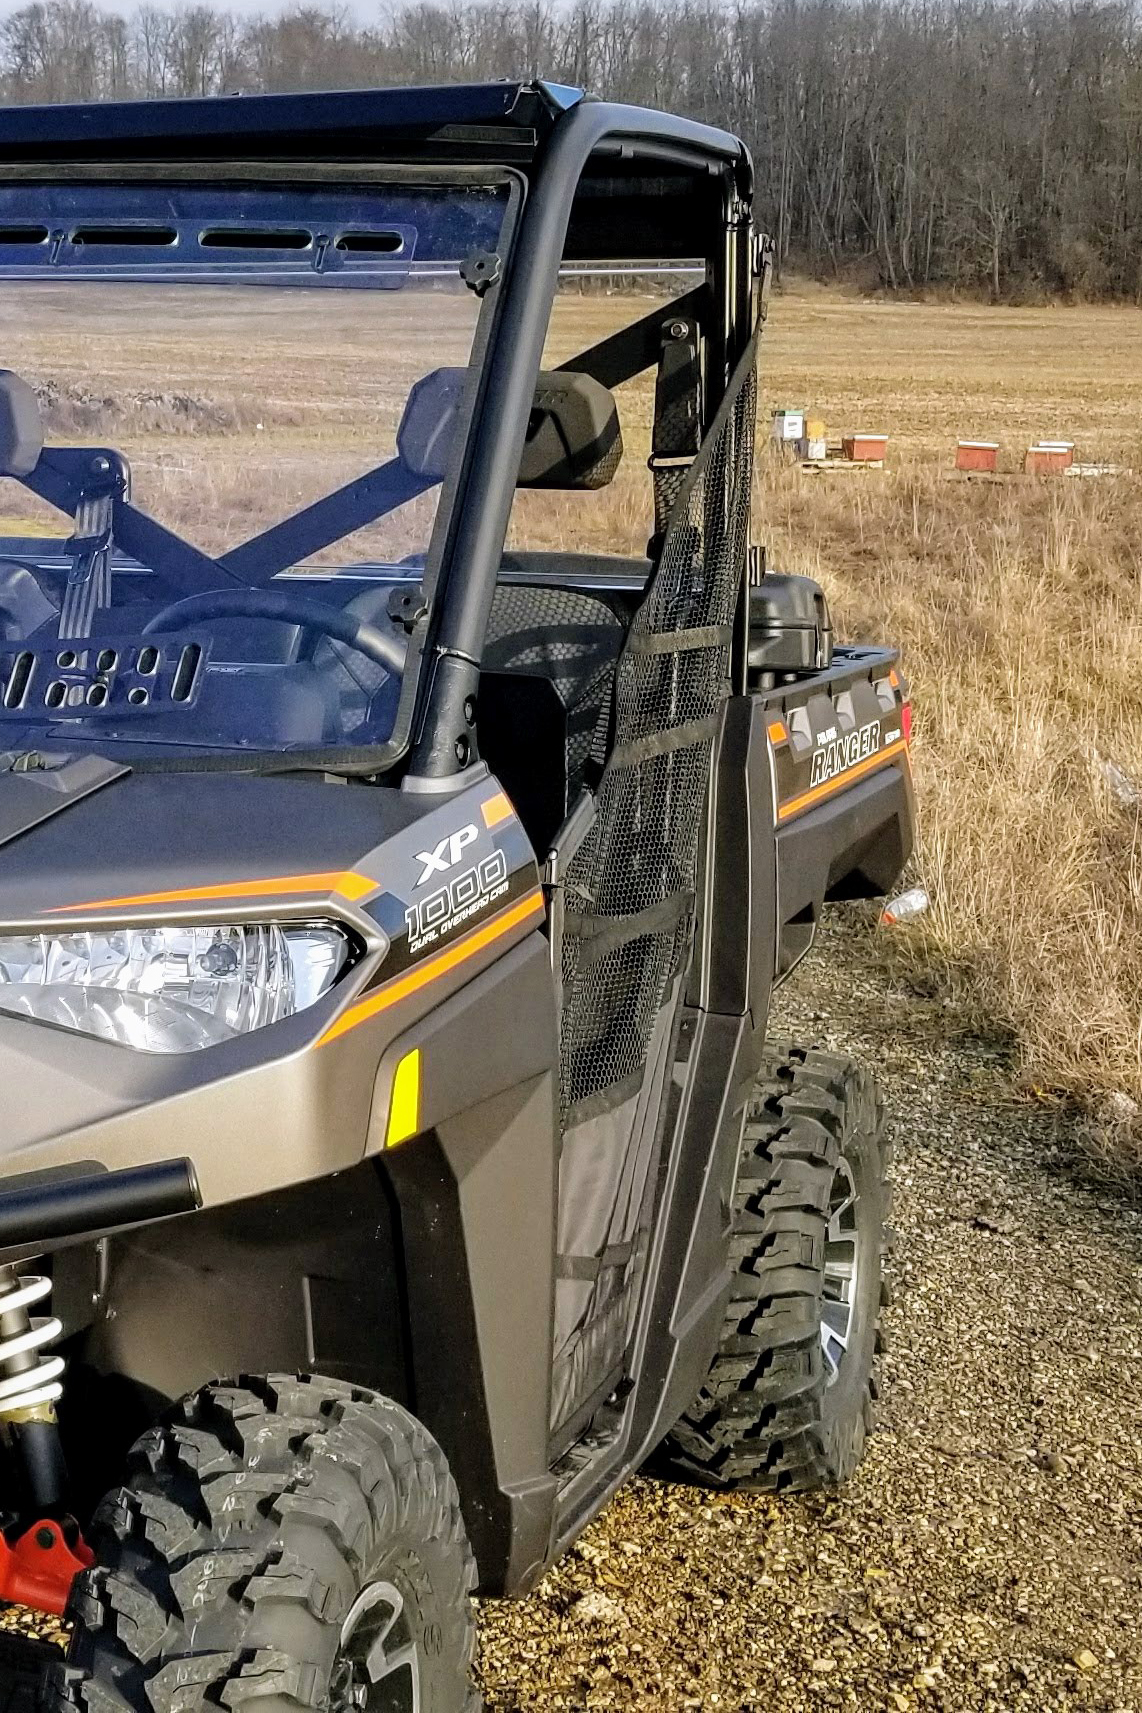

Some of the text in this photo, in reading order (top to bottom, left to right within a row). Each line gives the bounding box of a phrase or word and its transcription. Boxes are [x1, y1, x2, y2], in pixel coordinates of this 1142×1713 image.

[809, 719, 881, 788] RANGER
[412, 823, 479, 889] XP
[404, 848, 507, 943] 1000
[409, 881, 510, 954] DUAL OVERHEAD CAM
